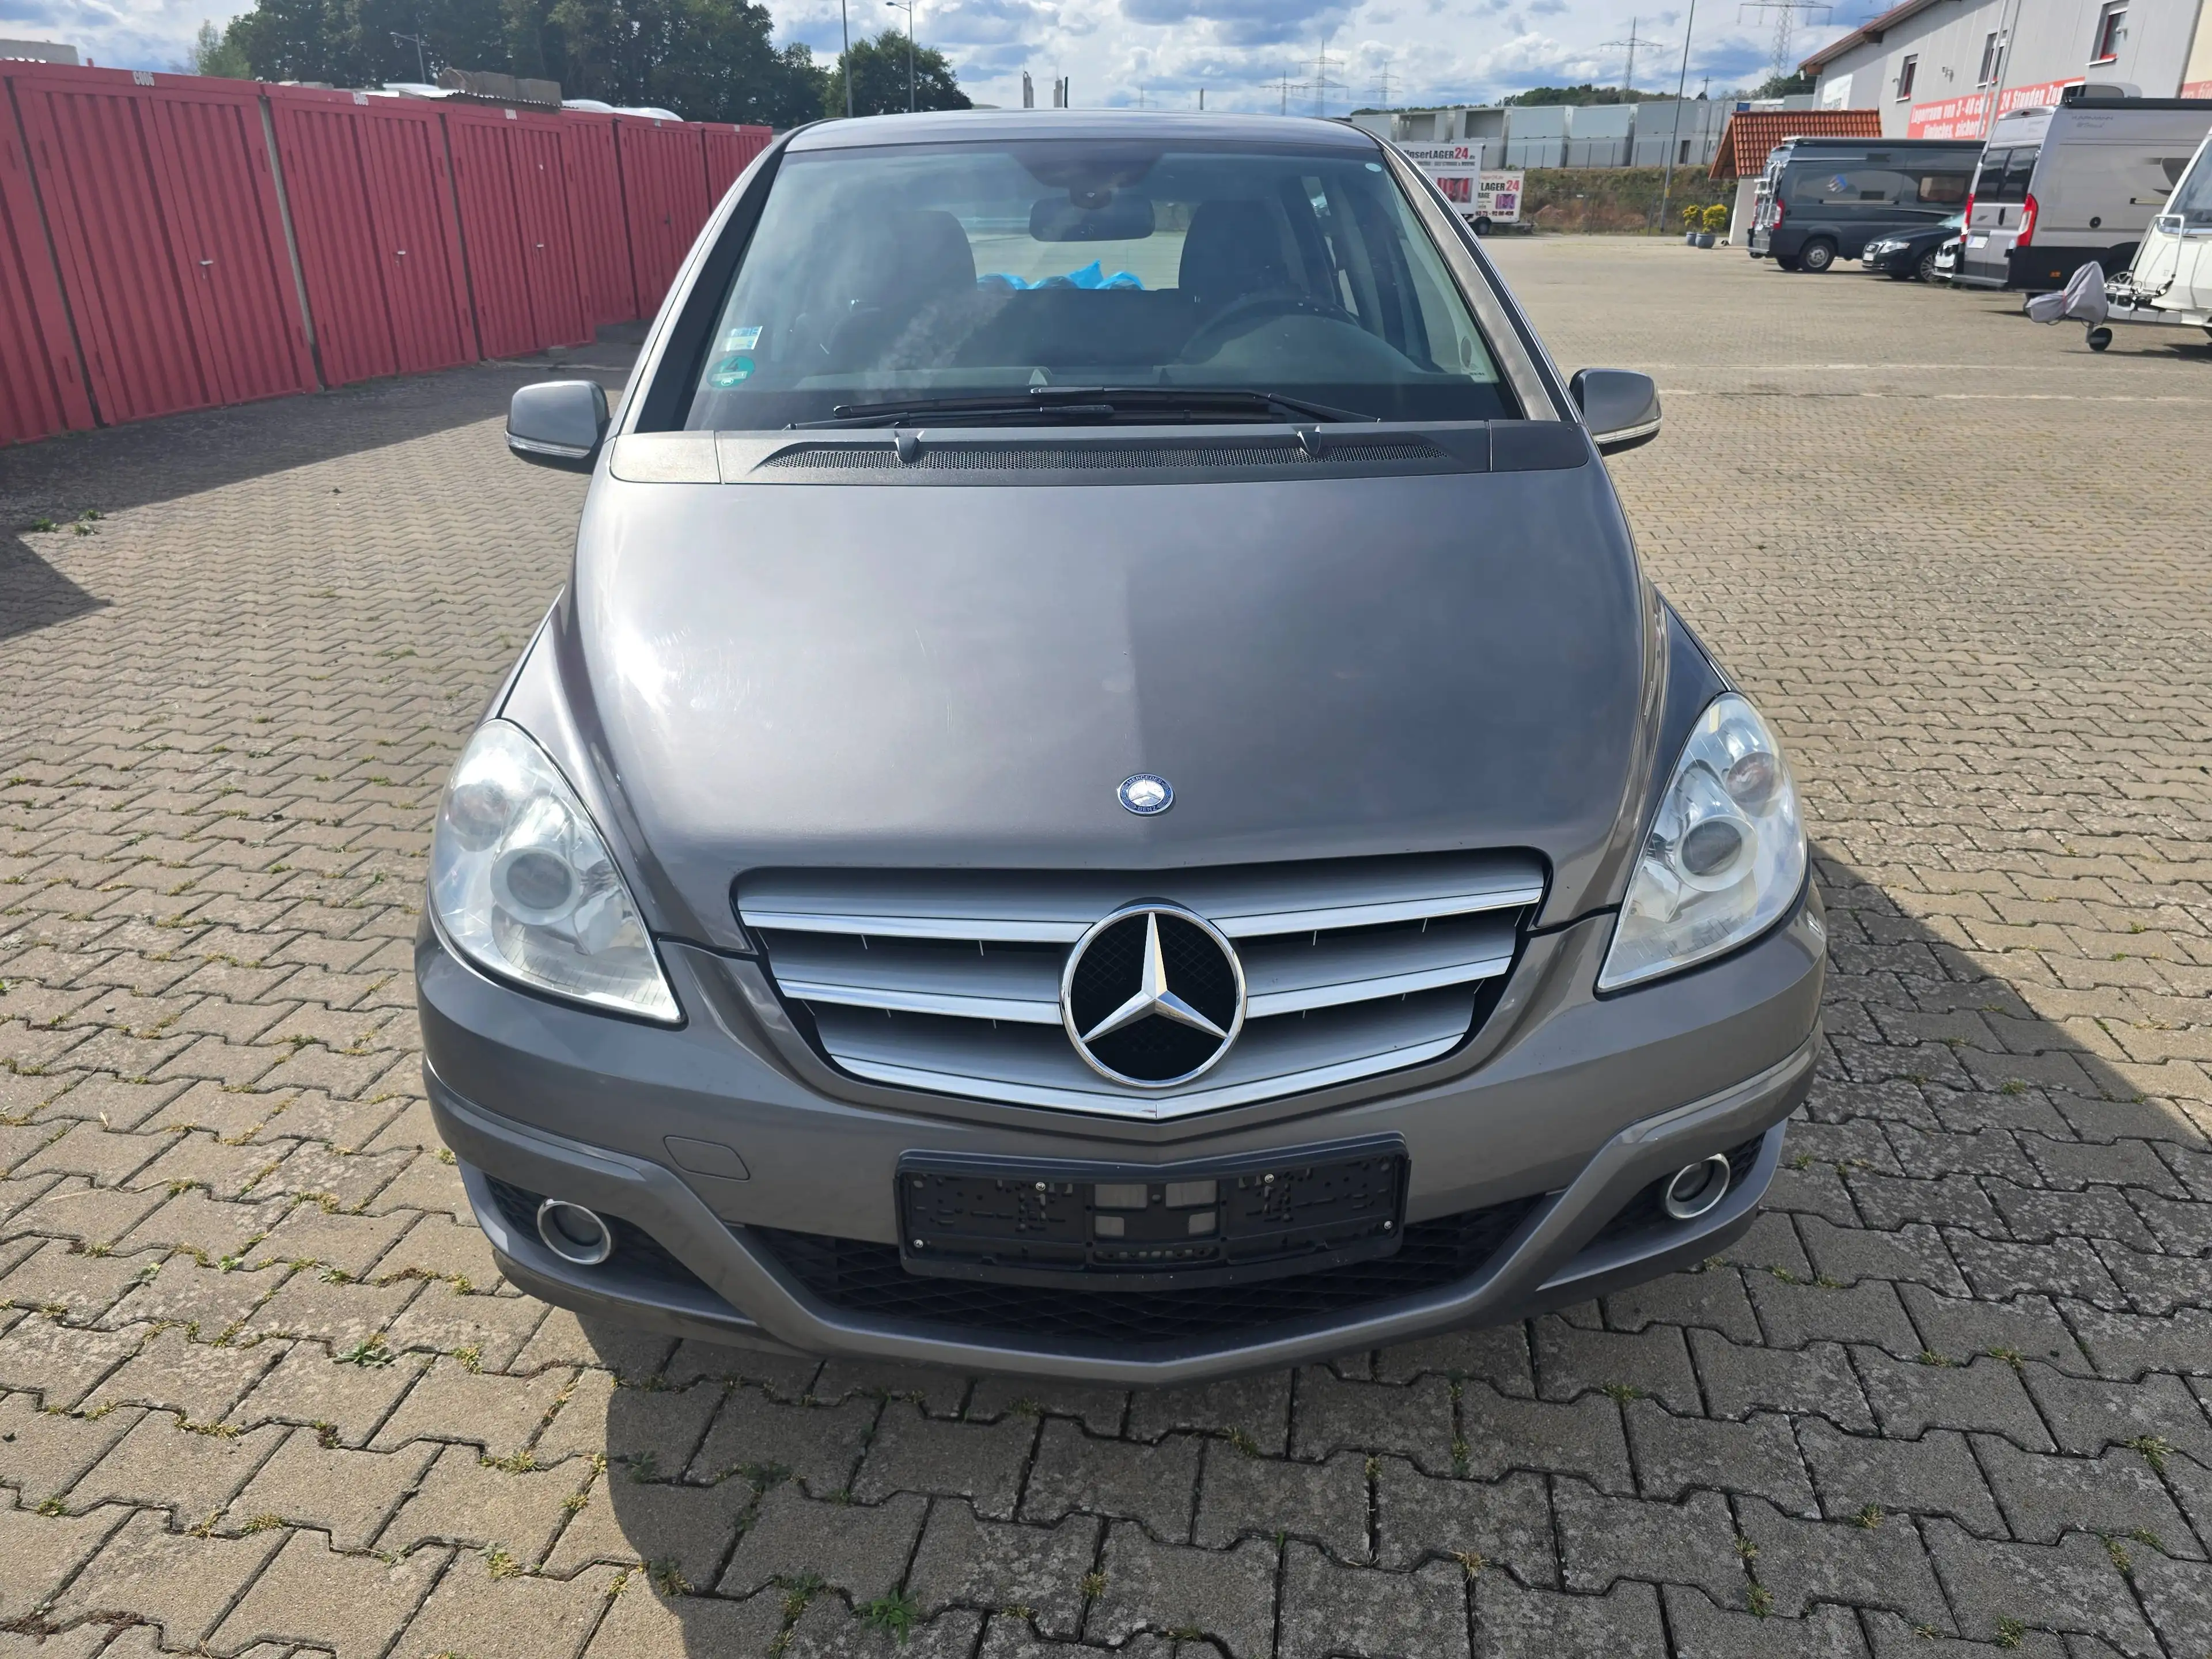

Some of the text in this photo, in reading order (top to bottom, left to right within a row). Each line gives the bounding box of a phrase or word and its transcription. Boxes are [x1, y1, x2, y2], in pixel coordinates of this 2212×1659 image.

[133, 71, 154, 86] C006
[2046, 85, 2064, 105] Zug
[1479, 180, 1520, 191] LAGER24
[725, 357, 739, 372] 4
[1127, 775, 1162, 785] MERCEDES
